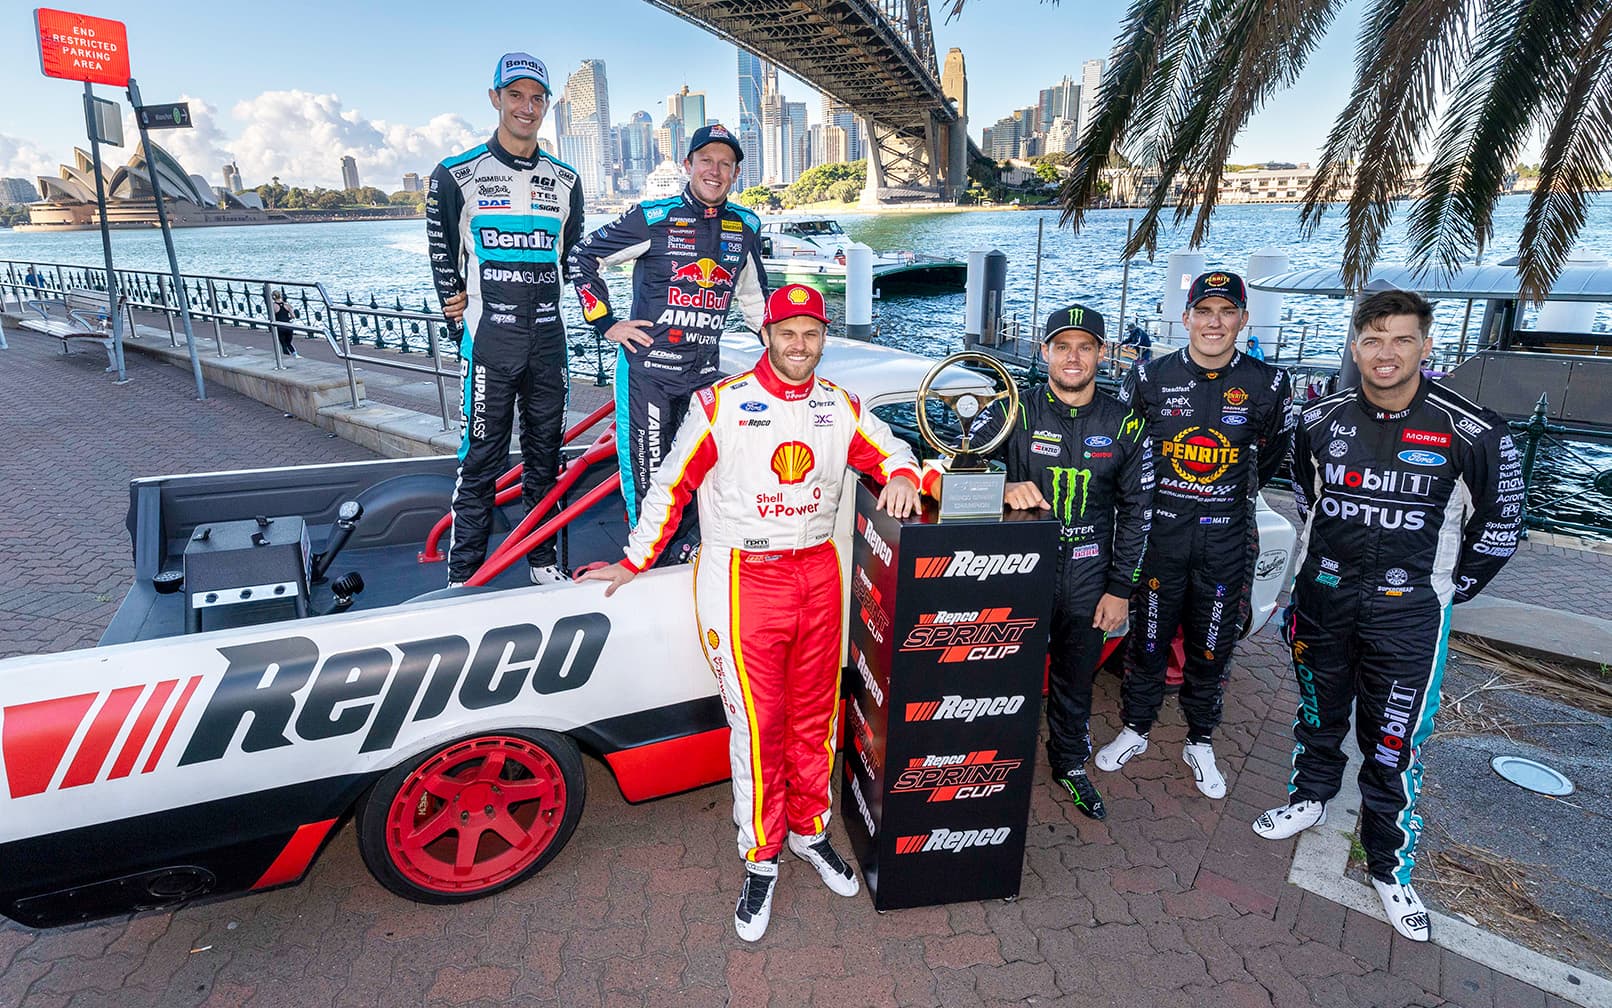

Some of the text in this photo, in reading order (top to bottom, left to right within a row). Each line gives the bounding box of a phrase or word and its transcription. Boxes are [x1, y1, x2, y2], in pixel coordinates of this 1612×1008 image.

[73, 27, 95, 37] END
[53, 34, 117, 51] RESTRICTED
[63, 47, 110, 61] PARKING
[74, 60, 103, 70] AREA
[506, 60, 544, 74] Bendix
[454, 168, 471, 179] OMP
[481, 229, 553, 249] Bendix
[667, 287, 731, 311] Red Bull
[657, 309, 725, 330] AMPOL
[1161, 408, 1192, 417] GROVE
[1304, 409, 1322, 421] OMP
[1376, 411, 1400, 419] Mobil
[1330, 420, 1357, 437] yes
[1458, 419, 1482, 436] OMP
[638, 429, 646, 465] Premium
[1406, 432, 1447, 444] MORRIS
[1161, 440, 1240, 465] PENRITE
[1160, 477, 1214, 493] RACING
[1325, 463, 1397, 493] Mobil
[756, 493, 783, 503] Shell
[758, 502, 820, 518] V-Power
[1321, 497, 1426, 531] OPTUS
[864, 518, 893, 568] Repco
[1481, 530, 1519, 542] NGK
[943, 551, 1040, 581] Repco
[1321, 560, 1339, 570] OMP
[933, 611, 979, 625] Repco
[1147, 591, 1159, 639] SINCE 1926
[866, 618, 884, 644] CUP
[903, 621, 1037, 648] SPRINT
[1206, 600, 1224, 651] SINCE 1926
[967, 645, 1021, 661] CUP
[857, 650, 884, 708] Repco
[177, 612, 611, 767] Repco
[1298, 664, 1321, 729] OPTUS
[932, 695, 1026, 722] Repco
[1375, 707, 1410, 769] Mobil
[860, 751, 876, 781] CUP
[921, 754, 966, 768] Repco
[893, 762, 1021, 789] SPRINT
[955, 784, 1006, 800] CUP
[851, 773, 876, 838] Repco
[921, 827, 1011, 853] Repco
